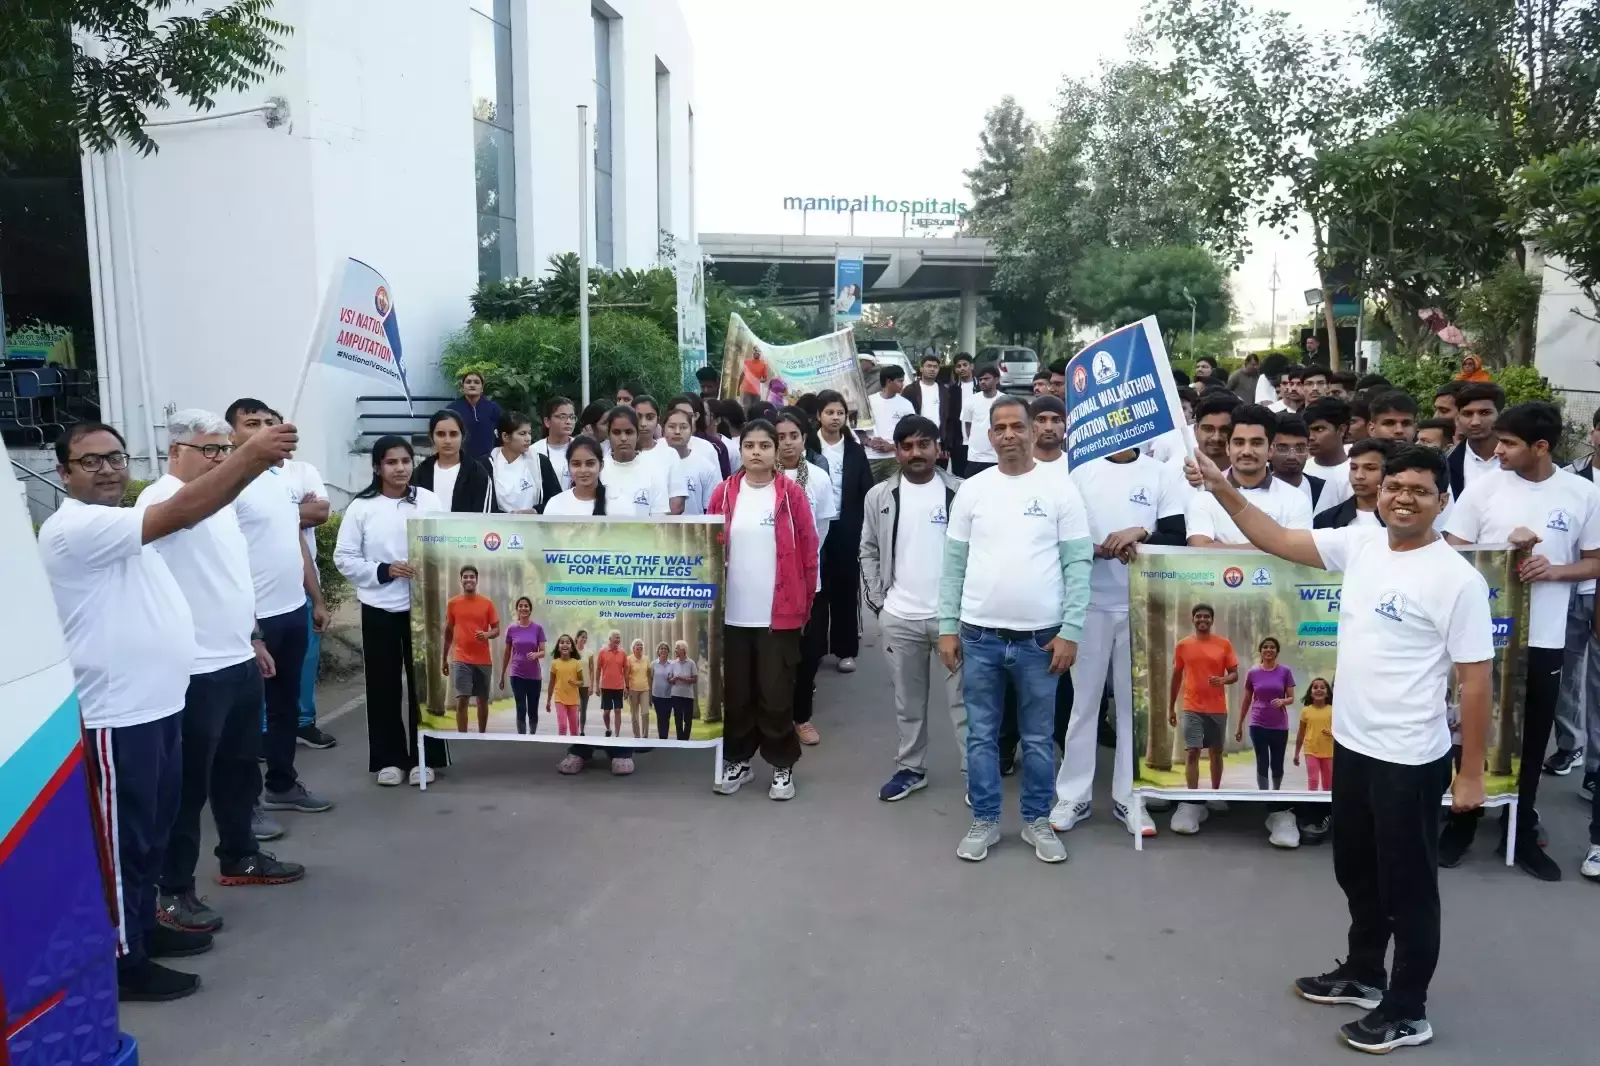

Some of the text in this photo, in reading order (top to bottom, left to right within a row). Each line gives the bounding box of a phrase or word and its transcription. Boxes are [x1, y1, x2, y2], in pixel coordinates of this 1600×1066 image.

[783, 195, 968, 217] manipalhospitals
[340, 307, 386, 339] VSI NATION
[336, 330, 392, 362] AMPUTATION
[1098, 373, 1156, 408] WALKATHON
[1069, 416, 1108, 450] MPUTATION
[1106, 407, 1133, 429] FREE
[1131, 398, 1159, 419] INDIA
[1073, 420, 1155, 461] #PreventAmputations
[545, 554, 703, 566] WELCOME TO THE WALK
[568, 565, 692, 577] FOR HEALTHY LEGS
[548, 585, 591, 593] Amputation
[637, 585, 712, 598] Walkathon
[1300, 589, 1342, 600] WELC
[652, 601, 682, 609] Society
[613, 611, 655, 619] November,
[1301, 625, 1338, 634] Amputa
